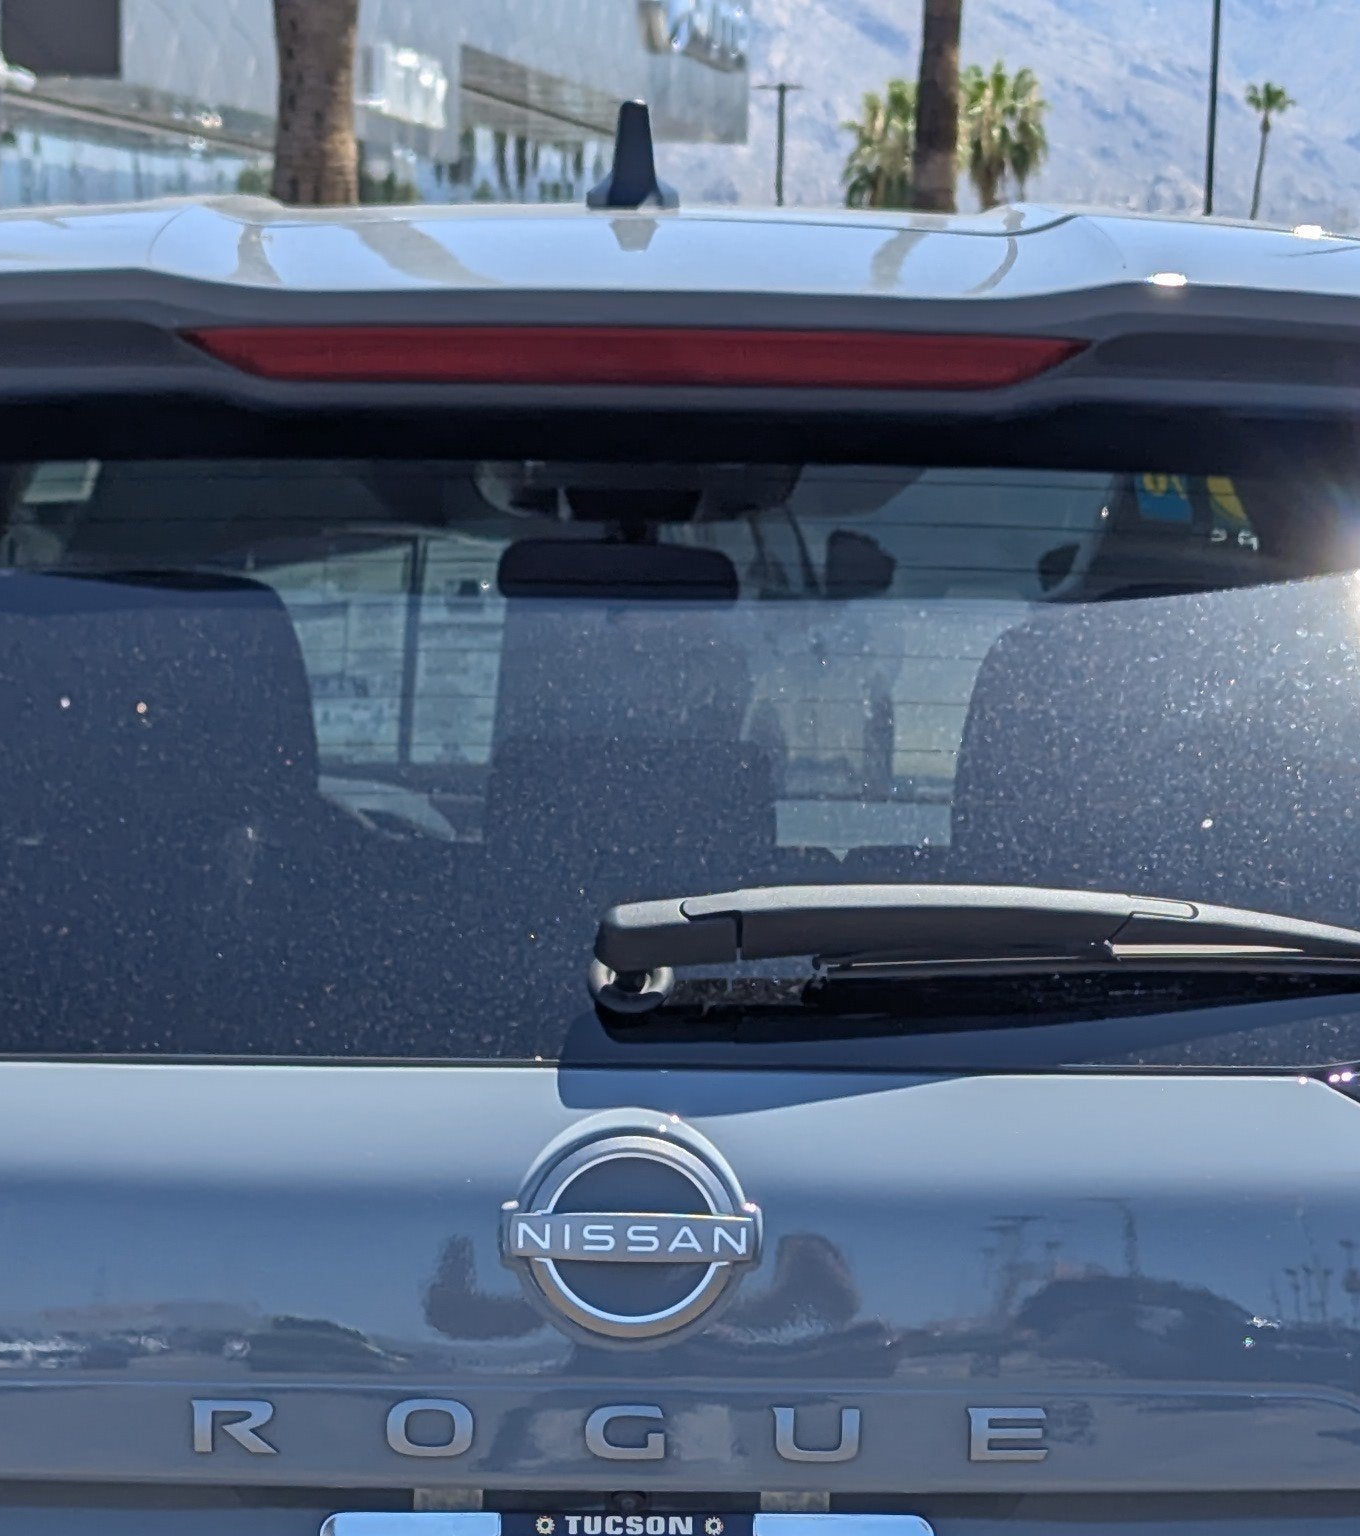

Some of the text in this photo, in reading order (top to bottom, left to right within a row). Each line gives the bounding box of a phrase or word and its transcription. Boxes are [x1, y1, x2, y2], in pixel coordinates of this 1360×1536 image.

[516, 1221, 747, 1255] NISSAN
[189, 1398, 1050, 1463] ROGUE
[564, 1515, 693, 1536] TUCSON
